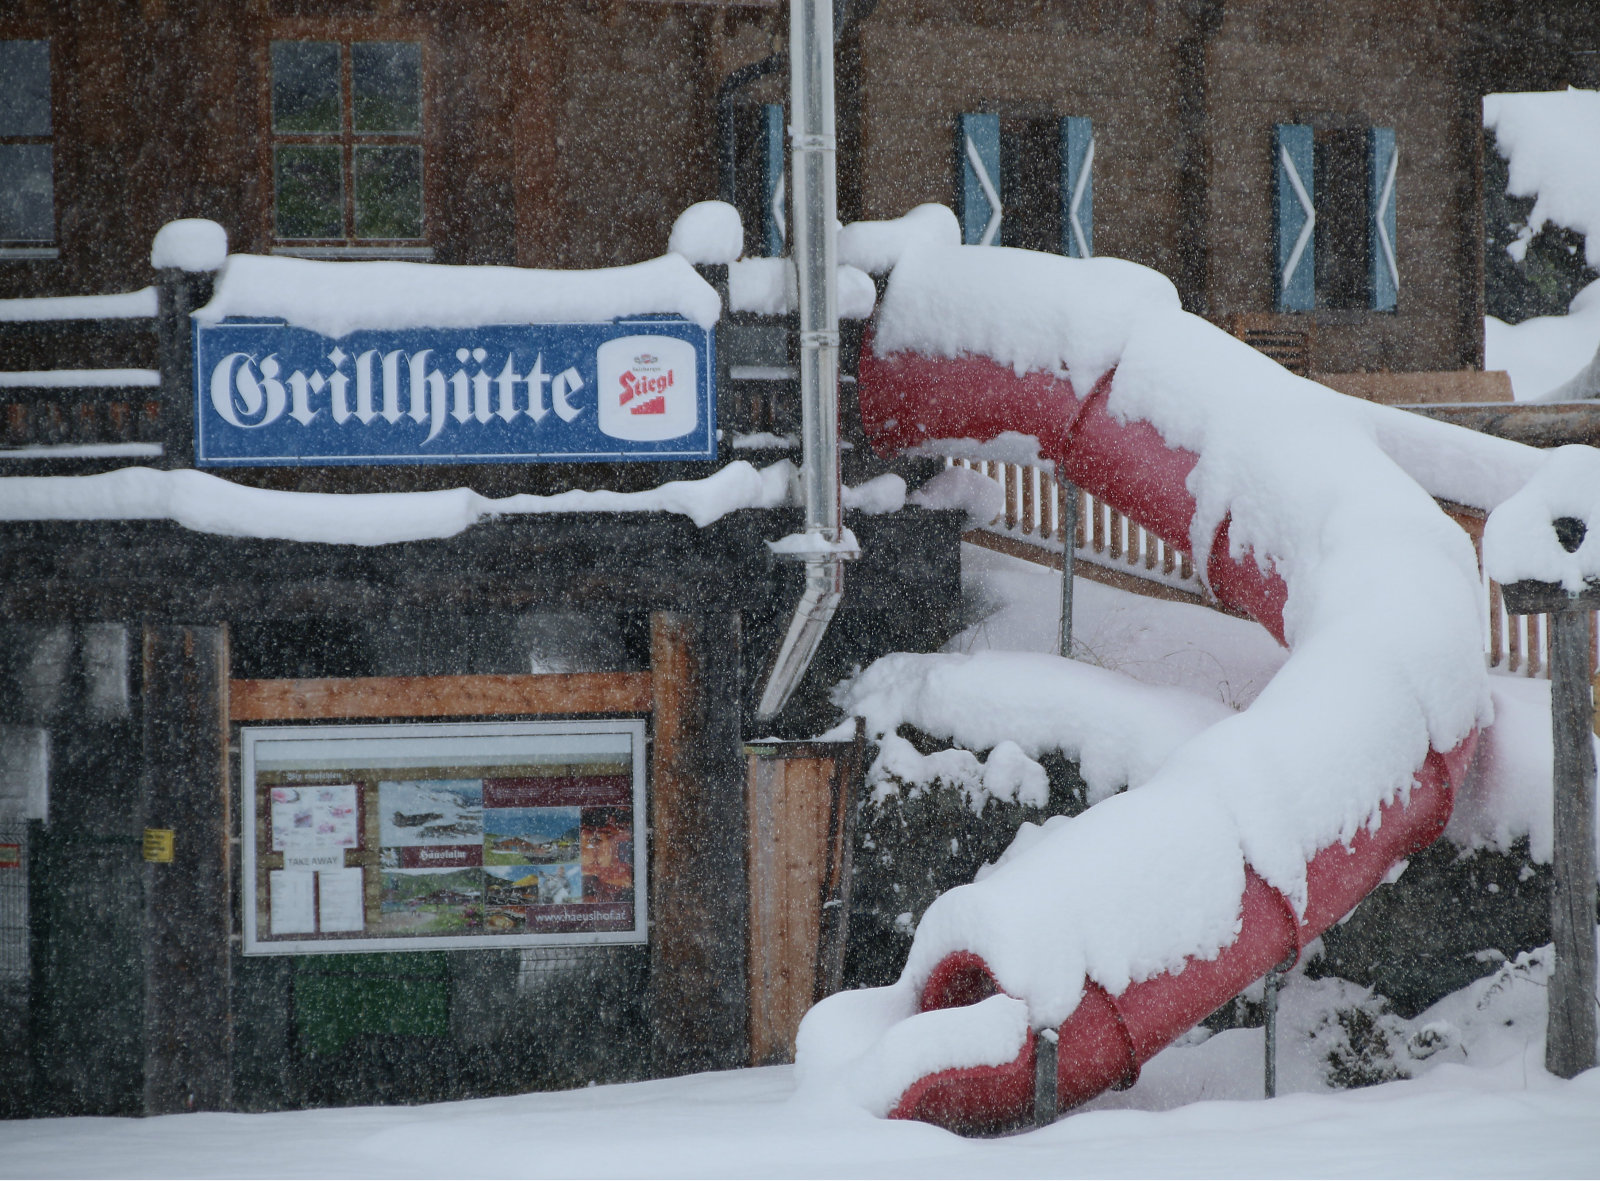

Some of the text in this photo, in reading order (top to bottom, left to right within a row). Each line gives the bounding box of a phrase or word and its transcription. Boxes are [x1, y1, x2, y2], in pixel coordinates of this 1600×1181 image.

[211, 346, 584, 446] Grillhütte
[619, 369, 674, 406] Stiegl
[288, 855, 338, 866] TAKE AWAY
[535, 910, 626, 922] www.haeuslhof.at
